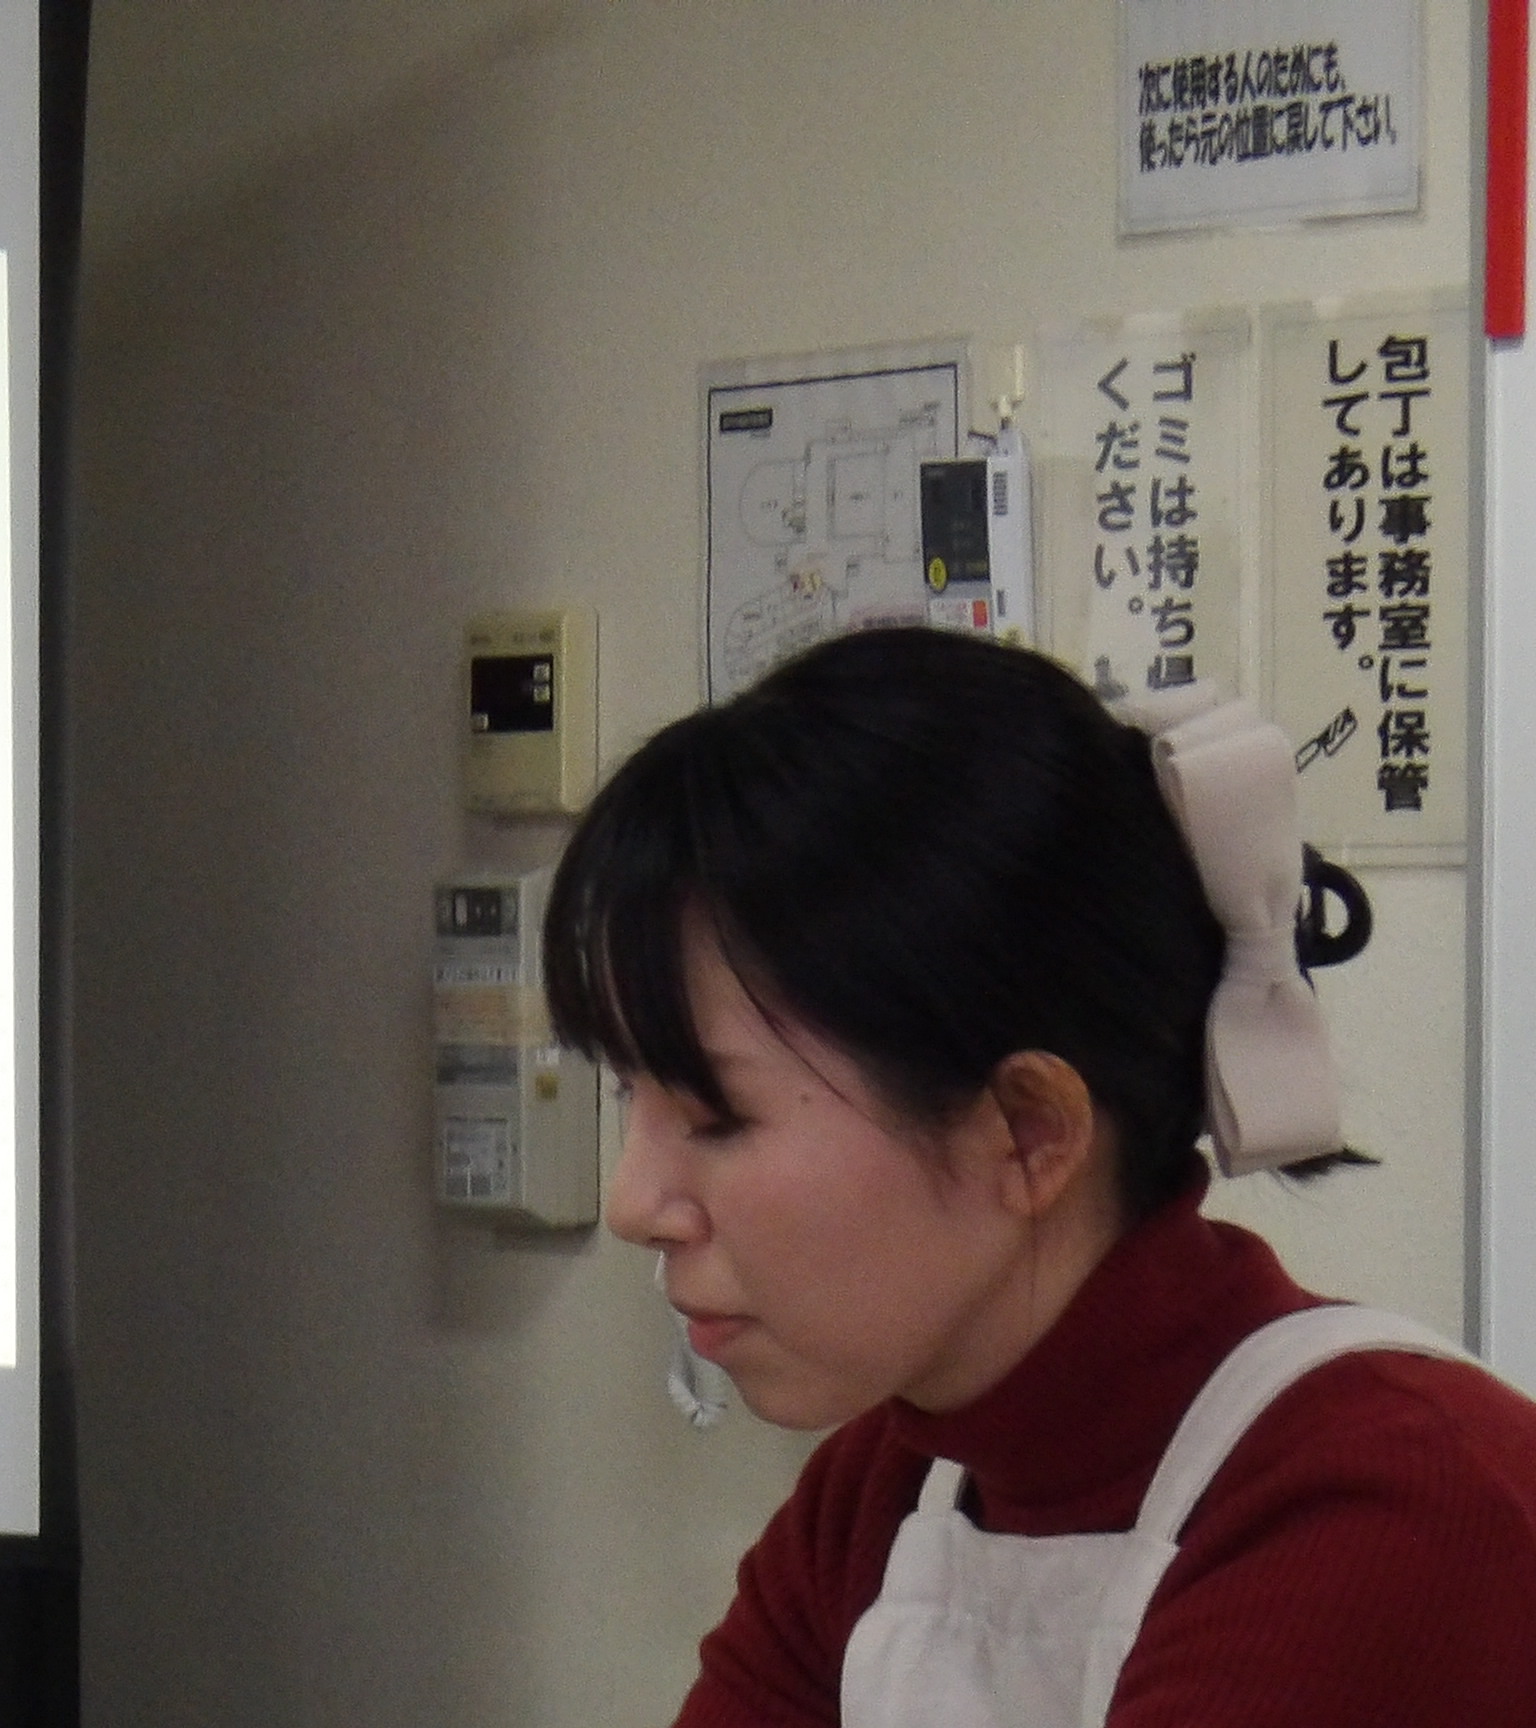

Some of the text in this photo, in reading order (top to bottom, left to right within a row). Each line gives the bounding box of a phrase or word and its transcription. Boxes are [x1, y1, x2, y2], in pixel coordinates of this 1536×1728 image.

[1095, 357, 1145, 613] ください。
[1322, 339, 1374, 671] してあります。
[1378, 335, 1431, 811] 包丁は事務室に保管
